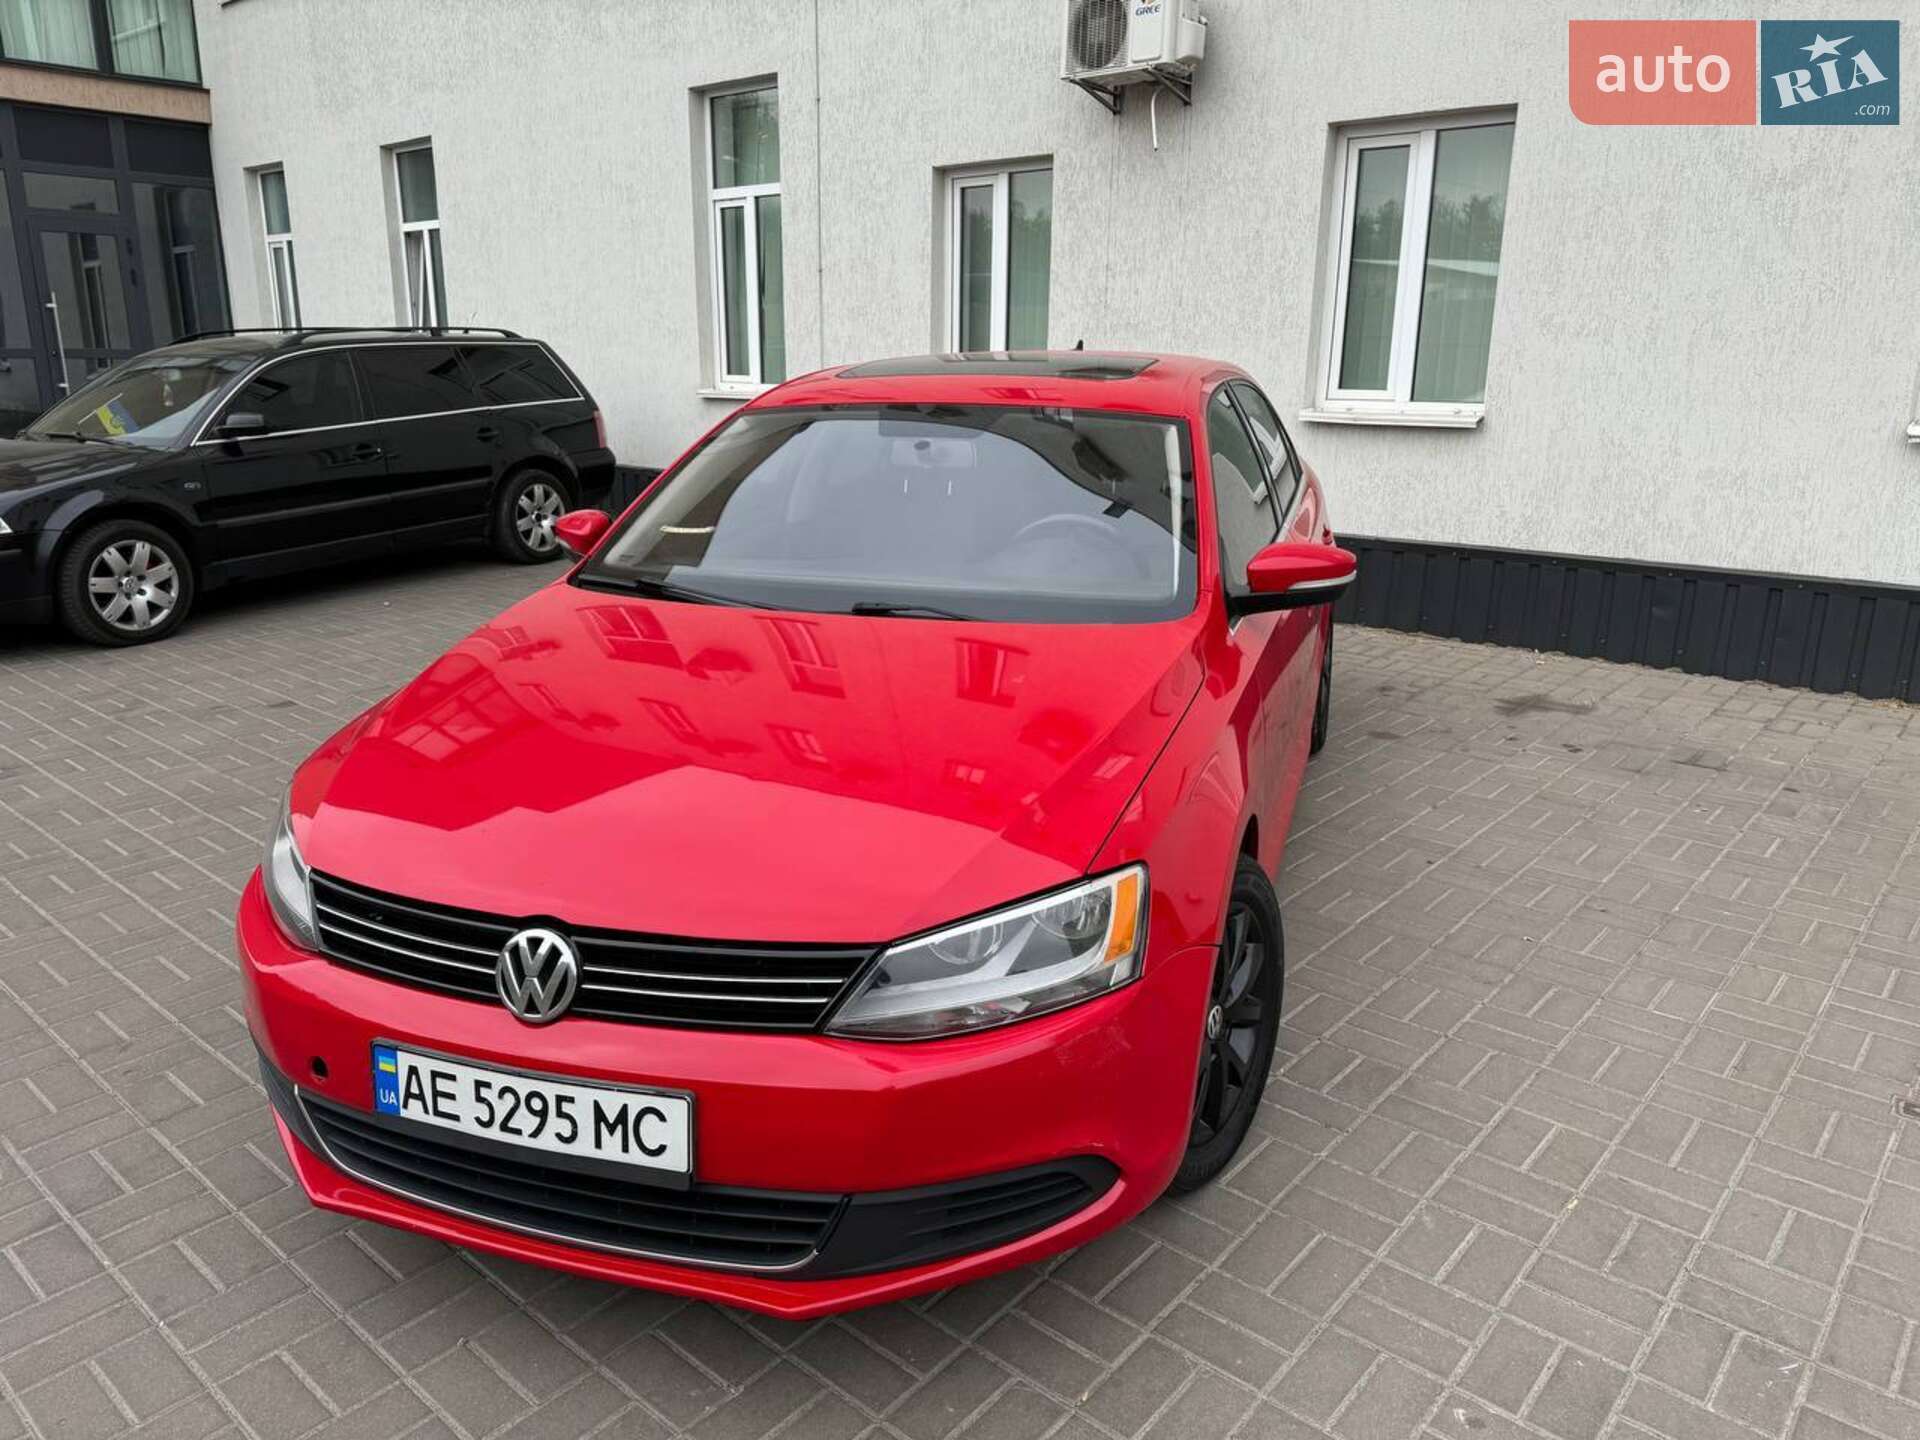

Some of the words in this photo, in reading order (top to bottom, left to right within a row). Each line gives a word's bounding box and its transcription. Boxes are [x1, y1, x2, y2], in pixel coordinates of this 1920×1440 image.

[380, 1087, 398, 1106] UA
[402, 1064, 461, 1122] AE
[473, 1079, 578, 1144] 5295
[593, 1099, 668, 1157] MC
